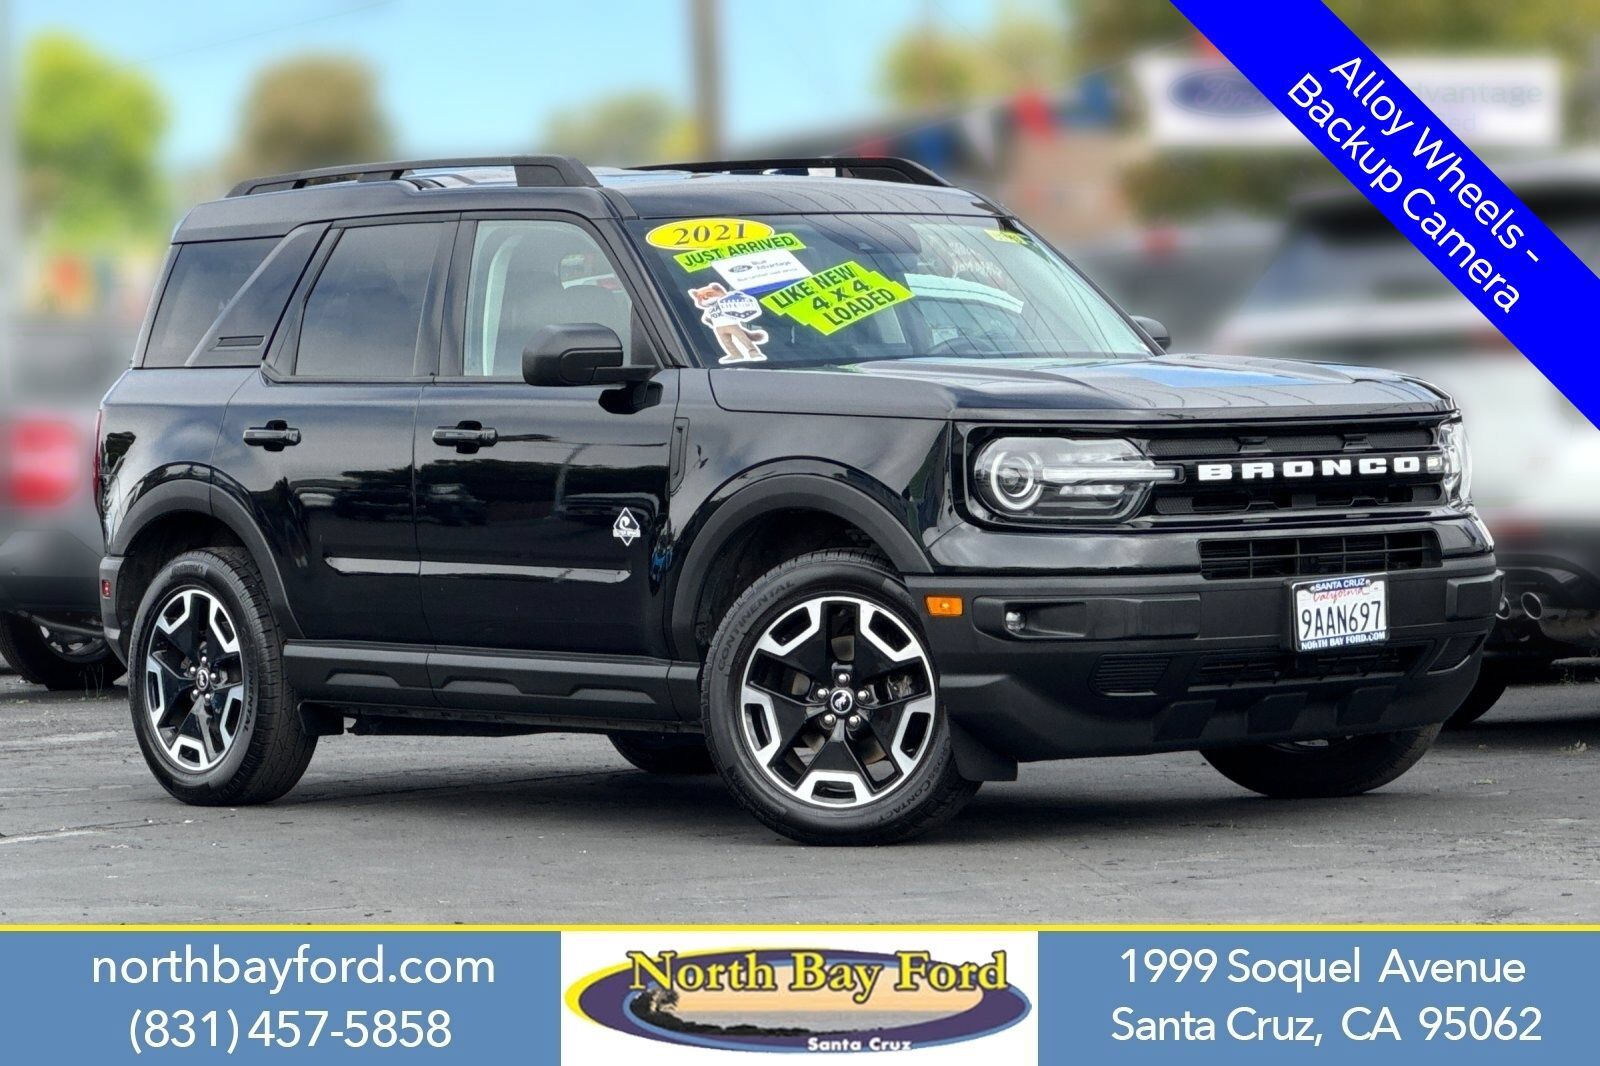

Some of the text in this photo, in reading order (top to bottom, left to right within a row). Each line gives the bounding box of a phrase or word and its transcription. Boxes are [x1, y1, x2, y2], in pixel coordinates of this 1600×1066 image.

[673, 222, 748, 246] 2021
[684, 234, 796, 268] JUST ARRIVED
[769, 278, 814, 310] LIKE
[811, 264, 858, 290] NEW
[812, 296, 828, 312] 4
[852, 278, 871, 293] 4
[821, 287, 896, 327] LOADED
[1197, 456, 1420, 481] BRONCO
[1315, 578, 1366, 592] SANTA CRUZ
[1301, 600, 1381, 640] 9AAN697
[1301, 631, 1386, 651] NORTH BAY FORD.COM
